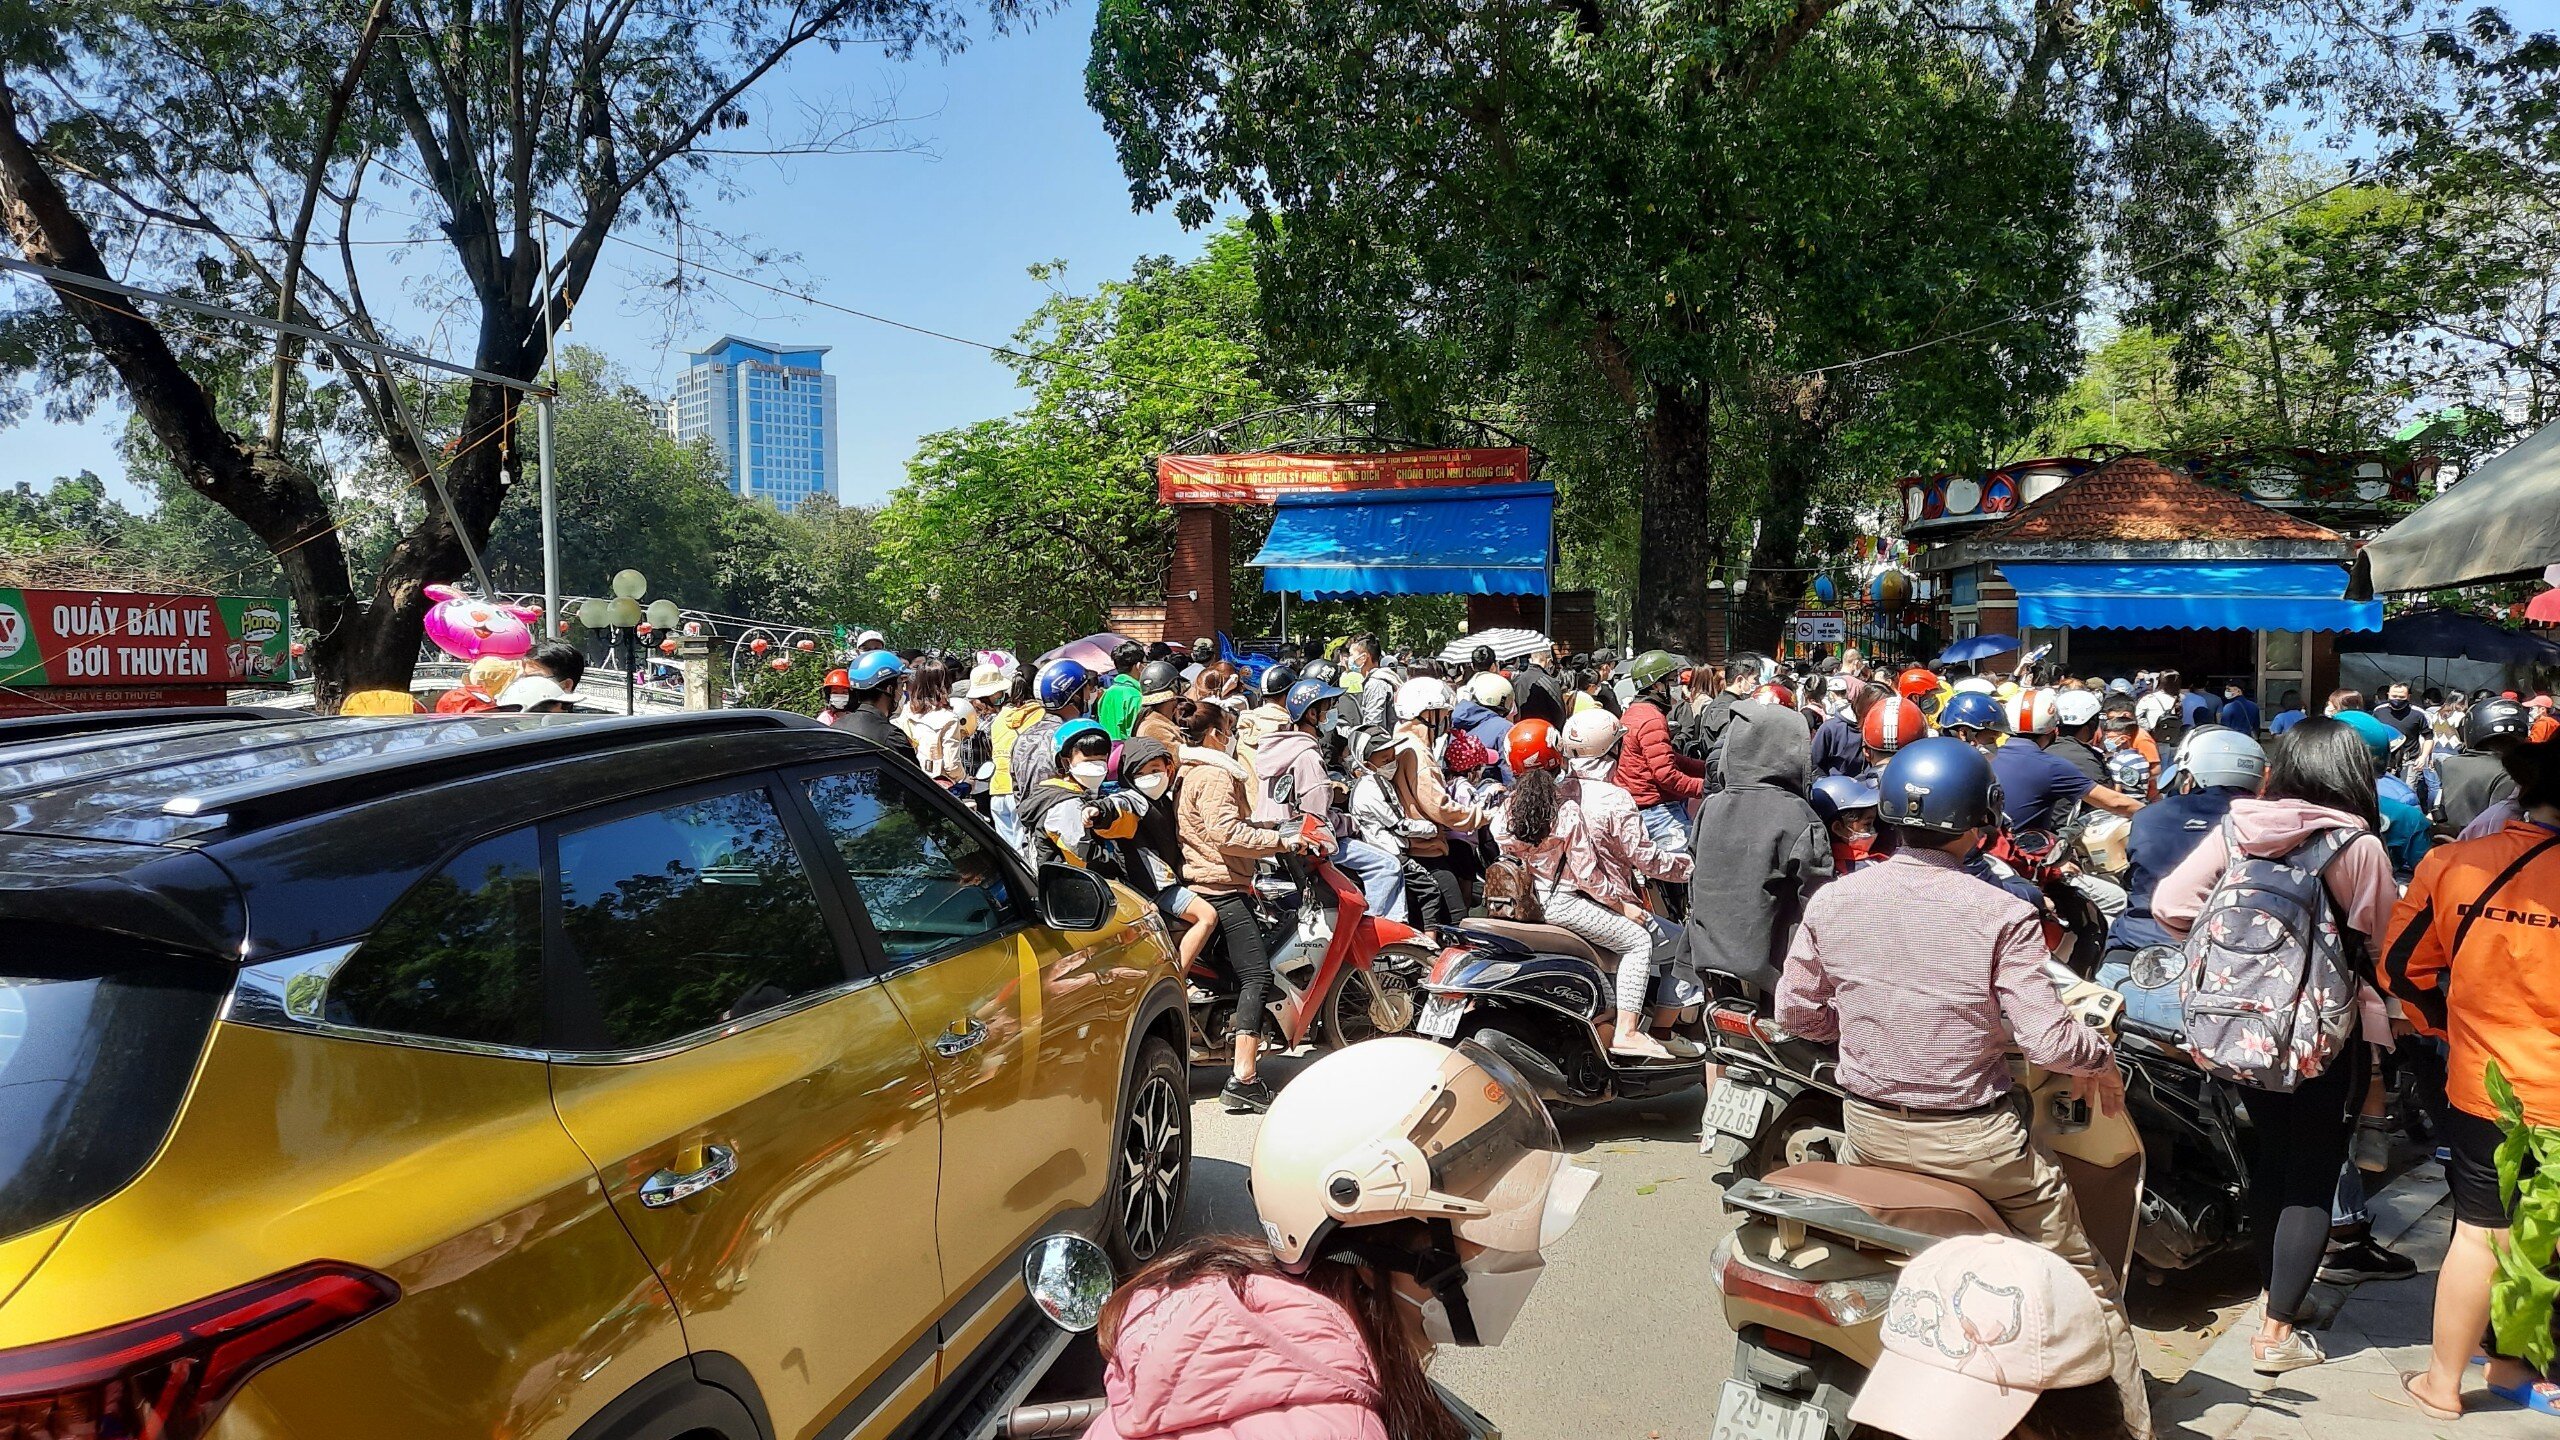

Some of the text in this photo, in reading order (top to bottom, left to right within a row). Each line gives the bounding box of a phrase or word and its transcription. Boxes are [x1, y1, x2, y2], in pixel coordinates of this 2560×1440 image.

[1233, 471, 1243, 484] LÀ
[1425, 467, 1445, 482] DỊCH
[1465, 463, 1494, 479] CHỐNG
[54, 596, 211, 638] QUẦY BÁN VÉ
[67, 639, 208, 677] BƠI THUYỀN
[1421, 1013, 1456, 1035] 156.16
[1706, 1103, 1757, 1135] 372.05
[1730, 1389, 1810, 1440] 29-N1
